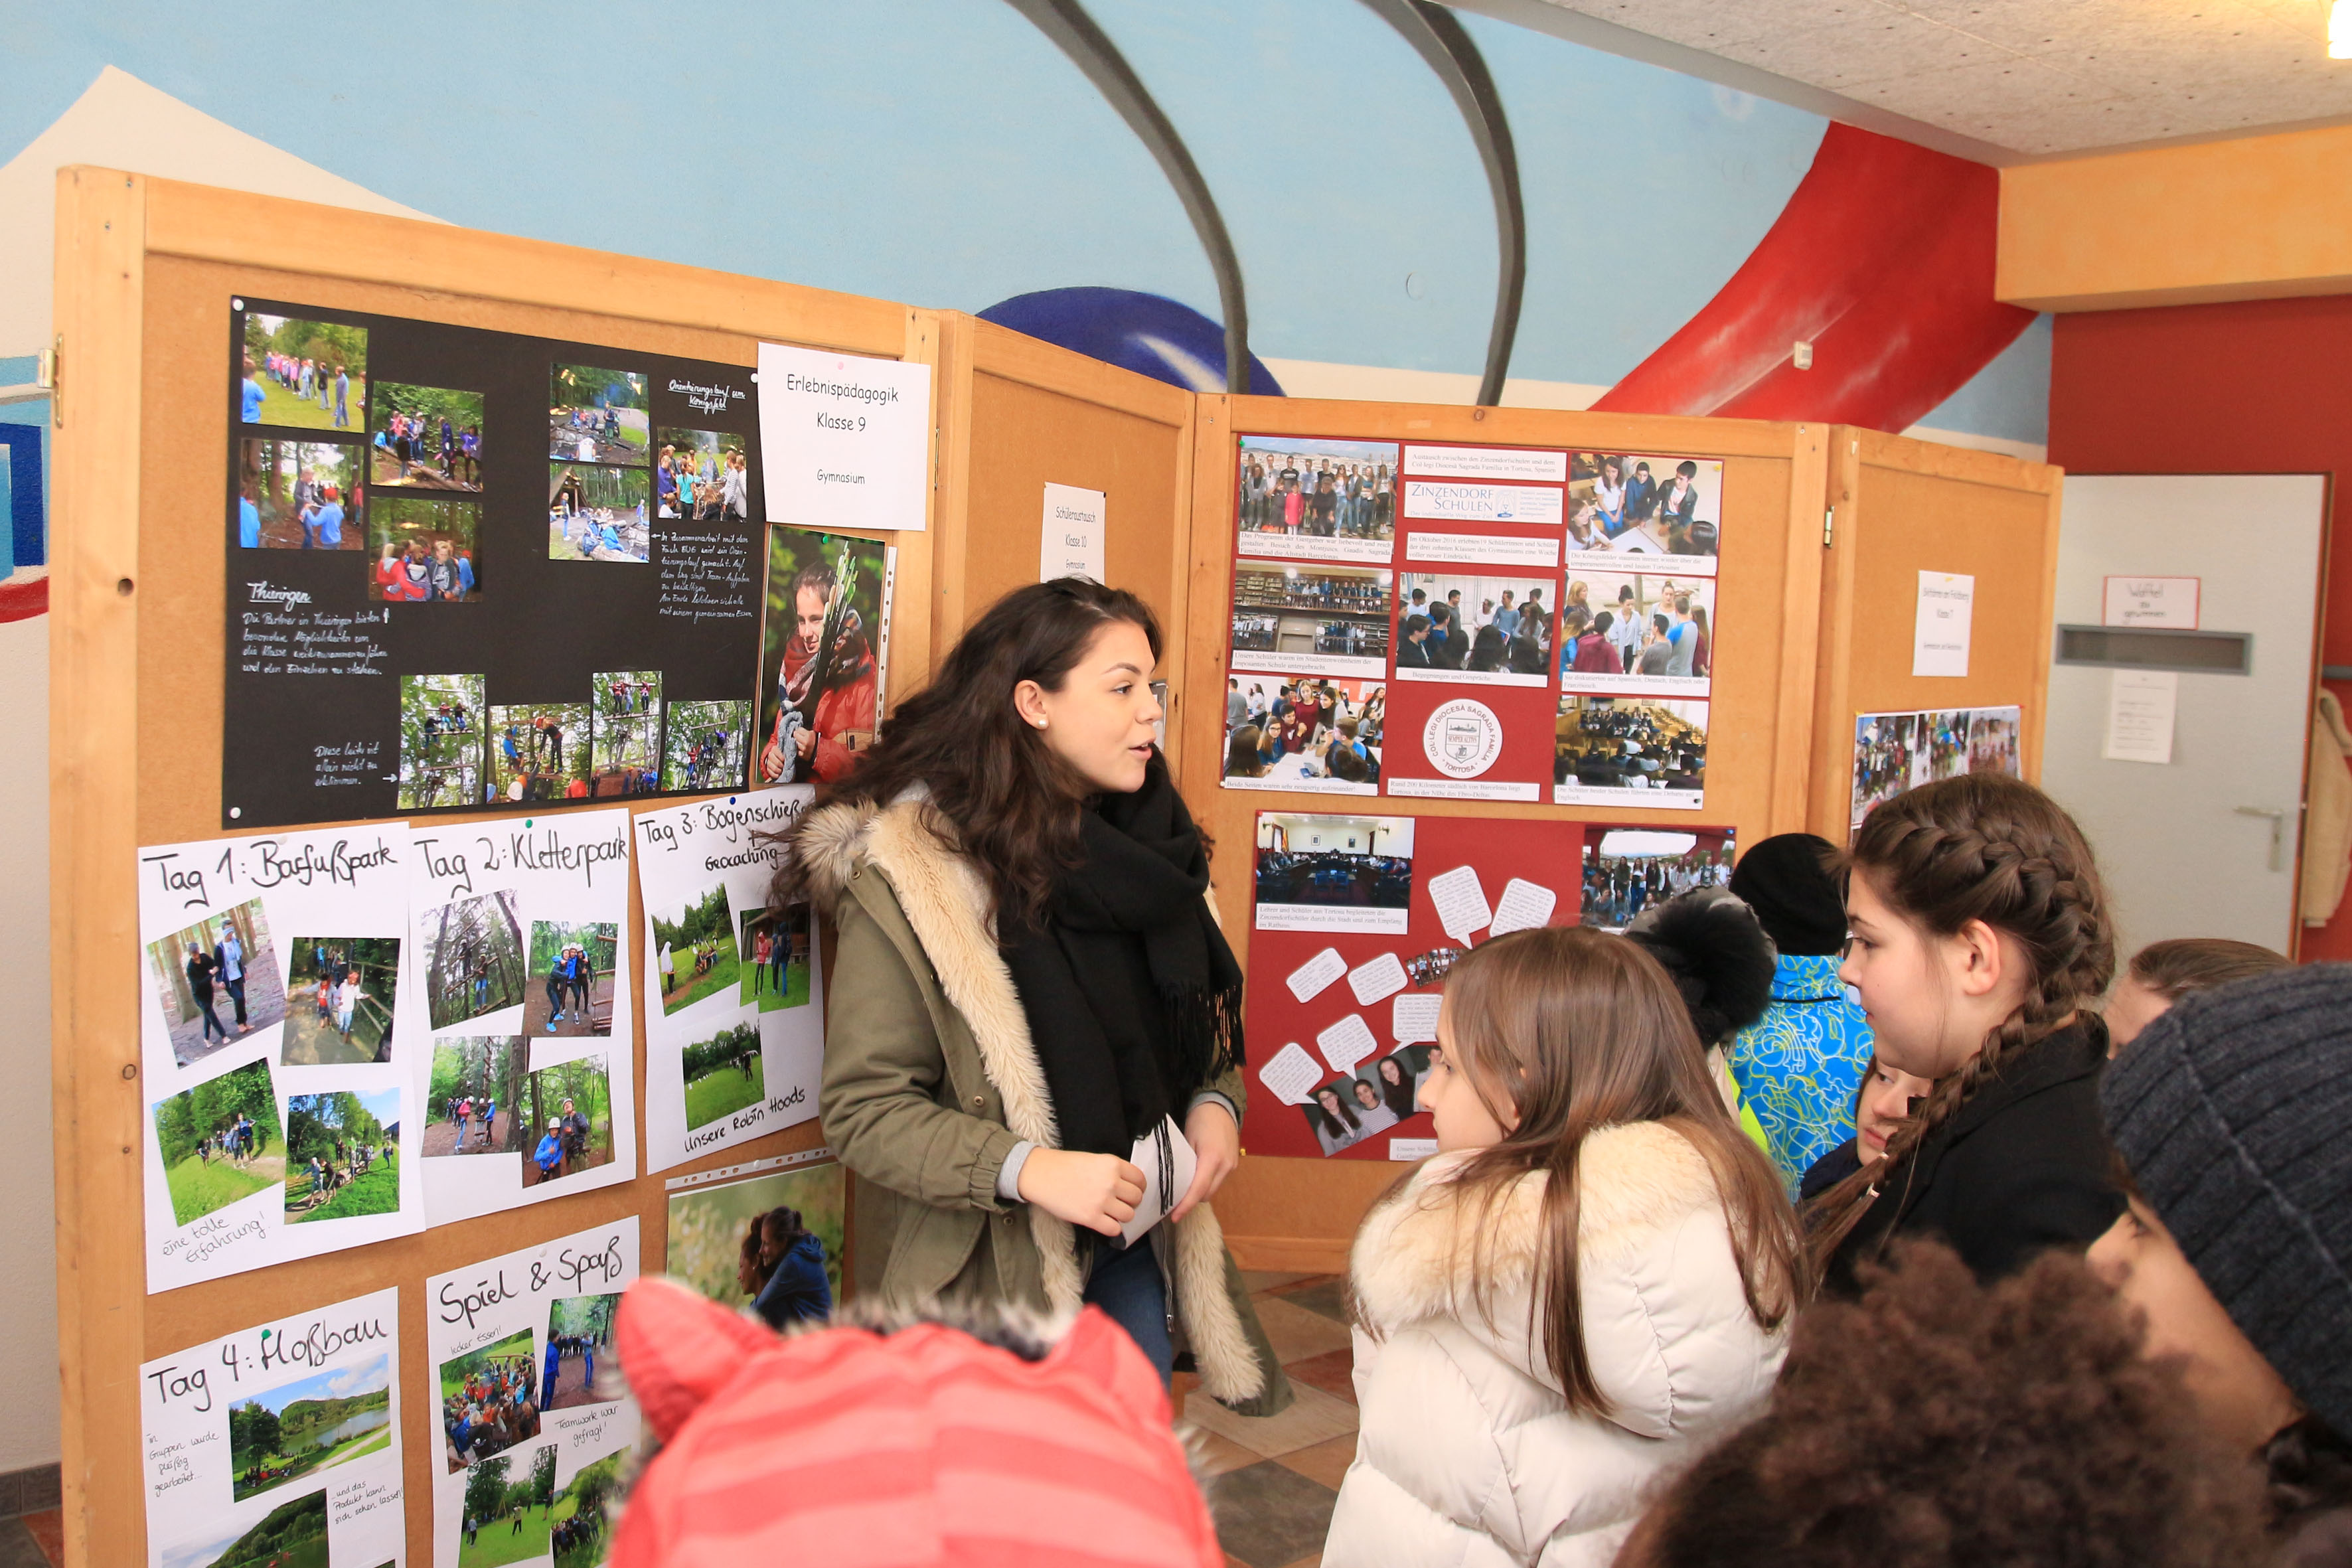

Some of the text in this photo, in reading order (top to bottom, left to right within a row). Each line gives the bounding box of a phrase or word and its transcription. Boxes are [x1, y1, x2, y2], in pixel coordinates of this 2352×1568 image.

[787, 374, 898, 406] Erlebnispädagogik
[817, 412, 866, 431] Klasse 9
[817, 469, 865, 484] Gymnasium
[1411, 484, 1494, 499] ZINZENDORF
[1435, 498, 1492, 511] SCHULEN
[1056, 507, 1096, 523] Schüleraustausch
[661, 531, 667, 541] In
[723, 533, 734, 543] mit
[736, 534, 748, 543] dem
[1065, 534, 1087, 548] Klasse 10
[1255, 533, 1283, 542] Programm
[733, 558, 745, 572] Auf
[1066, 559, 1085, 570] Gymnasium
[690, 571, 704, 580] sind
[246, 581, 311, 611] Thüringen
[672, 594, 688, 603] Ende
[720, 595, 732, 605] sich
[262, 613, 295, 625] Partner
[1436, 704, 1466, 723] DIOCESÀ
[1468, 706, 1494, 733] SAGRADA
[314, 746, 341, 757] Diese
[342, 758, 365, 771] nicht
[1445, 762, 1475, 773] TORTOSA
[638, 820, 678, 852] Tag
[680, 813, 698, 834] 3:
[414, 826, 628, 899] Tag 2: Kletterpark
[705, 846, 779, 871] Geocaching
[143, 836, 398, 909] Tag 1: Barfußpark
[684, 1086, 805, 1152] Unsere Robin Hoods
[163, 1217, 229, 1256] eine tolle
[186, 1211, 271, 1263] Erfahrung!
[440, 1236, 622, 1329] Spiel & Spaß
[451, 1325, 502, 1354] lecker Essen!
[147, 1318, 388, 1412] Tag 4: Floßbau
[555, 1406, 618, 1429] Teamwork war
[574, 1421, 606, 1447] gefragt!
[150, 1431, 220, 1460] Gruppen wurde
[159, 1456, 189, 1475] fleißig
[352, 1481, 366, 1491] das
[333, 1485, 386, 1511] Produkt kann
[335, 1513, 353, 1524] sich
[356, 1503, 377, 1515] sehen
